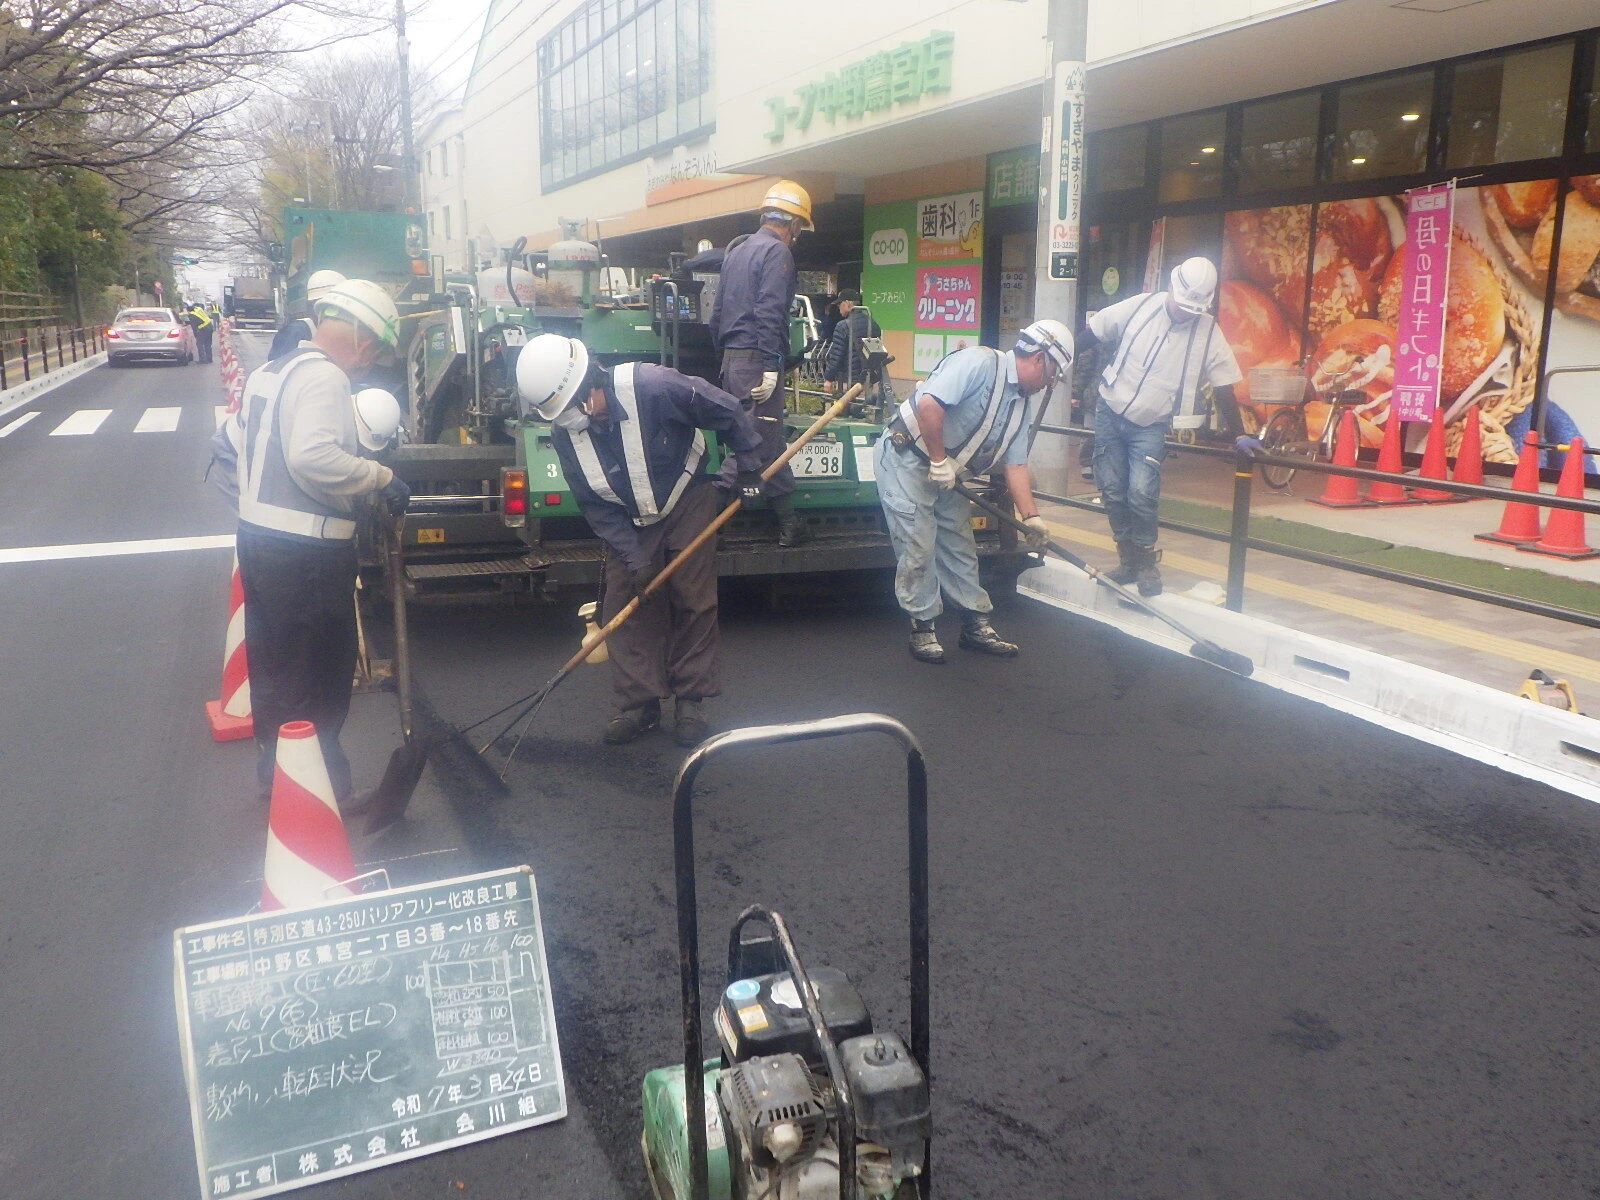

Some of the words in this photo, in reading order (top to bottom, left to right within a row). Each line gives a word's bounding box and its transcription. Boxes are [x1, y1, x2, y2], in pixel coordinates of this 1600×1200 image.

[921, 201, 957, 238] 歯科
[918, 297, 976, 323] クリーニング
[546, 463, 558, 478] 3
[405, 974, 425, 991] 100
[213, 1164, 273, 1195] 施工者
[298, 1127, 421, 1175] 株式会社
[455, 1093, 537, 1134] 会川組
